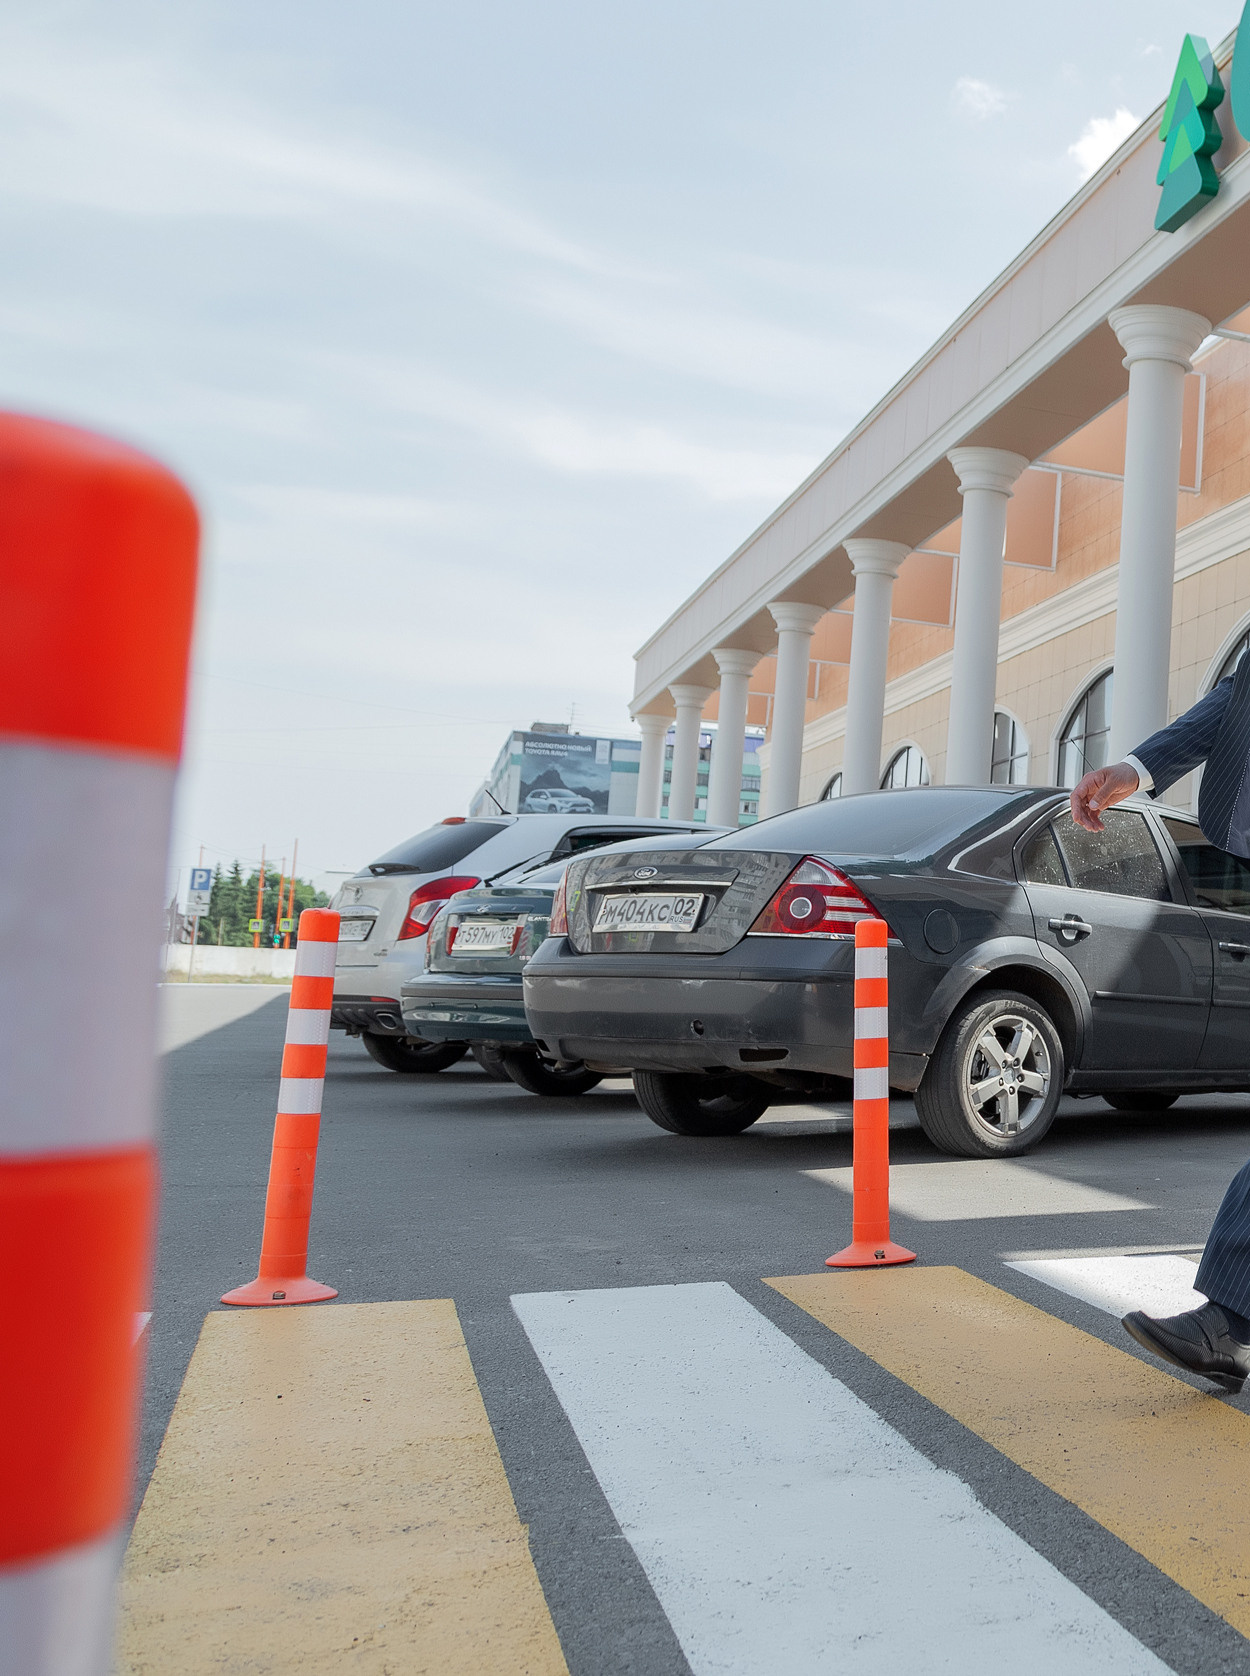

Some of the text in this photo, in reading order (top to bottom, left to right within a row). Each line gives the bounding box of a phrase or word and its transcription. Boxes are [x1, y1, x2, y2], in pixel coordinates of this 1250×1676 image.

[525, 741, 592, 752] АБСОЛЮТНО НОВЫЙ
[525, 748, 550, 756] TOYOTA
[193, 870, 207, 889] P
[675, 898, 695, 916] 02
[670, 915, 684, 923] RUS
[500, 926, 515, 939] 102
